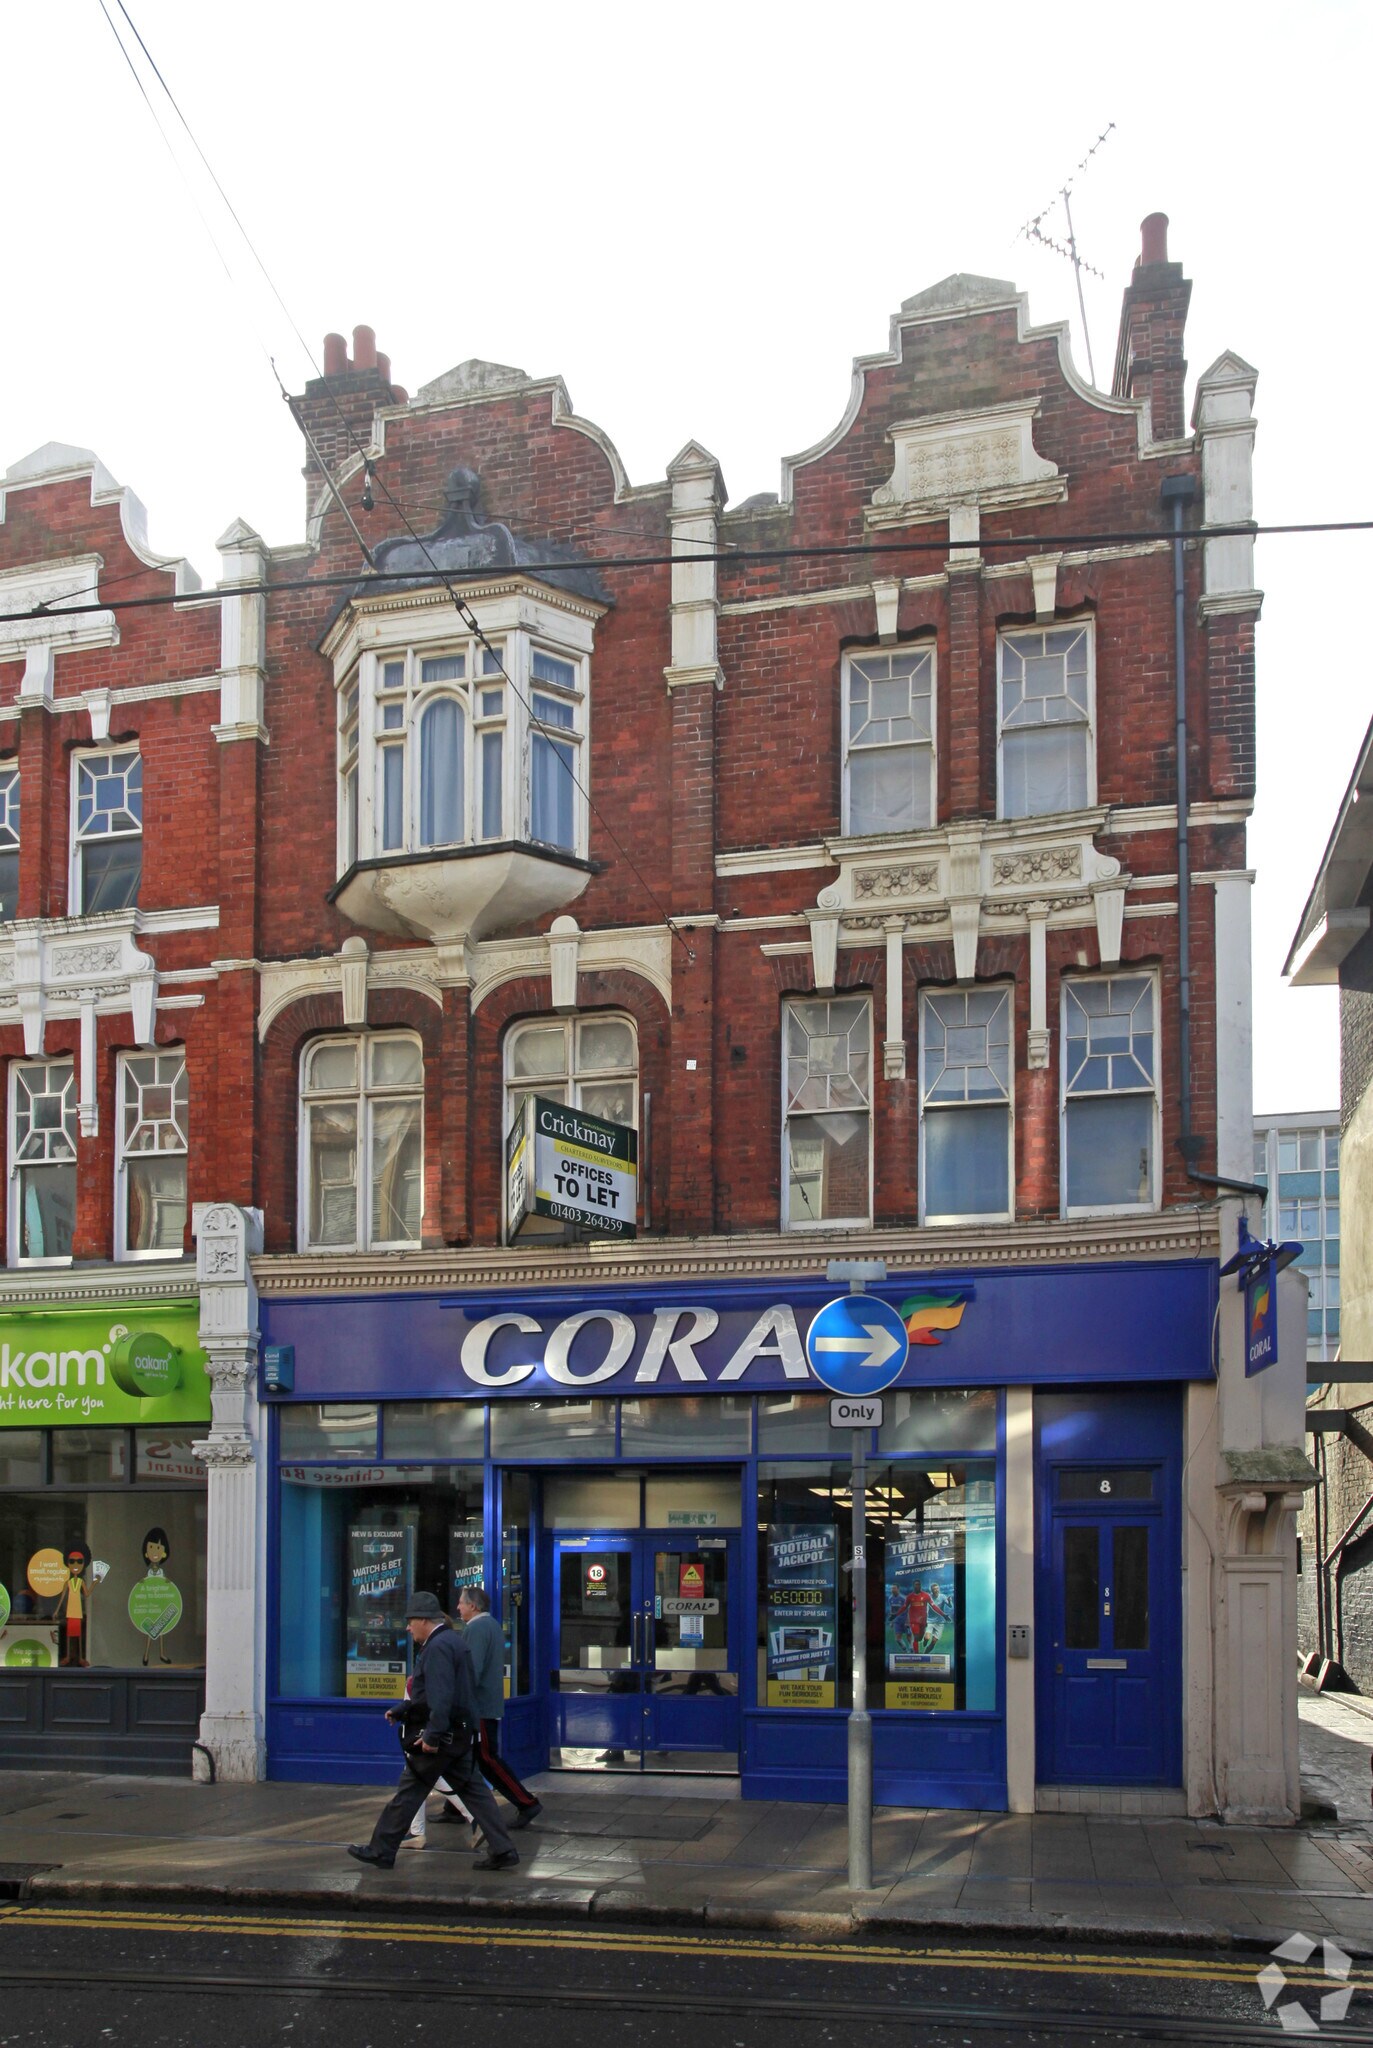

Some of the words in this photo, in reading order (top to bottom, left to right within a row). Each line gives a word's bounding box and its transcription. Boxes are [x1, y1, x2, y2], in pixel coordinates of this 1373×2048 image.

[540, 1111, 616, 1155] Crickmay
[560, 1145, 592, 1160] CHARTERED
[593, 1155, 623, 1169] SURVEYORS
[561, 1159, 613, 1186] OFFICES
[554, 1173, 580, 1198] TO
[586, 1183, 620, 1209] LET
[550, 1202, 582, 1222] 01403
[585, 1212, 623, 1233] 264259
[460, 1303, 810, 1387] CORA
[1250, 1335, 1272, 1362] CORAL
[135, 1355, 169, 1371] oakam
[18, 1394, 53, 1410] here
[55, 1392, 77, 1411] for
[81, 1394, 105, 1416] you
[838, 1405, 875, 1421] Only
[1100, 1480, 1111, 1493] 8
[773, 1536, 829, 1556] FOOTBALL
[855, 1546, 862, 1555] S
[891, 1541, 916, 1555] TWO
[917, 1536, 949, 1550] WAYS
[778, 1550, 824, 1567] JACKPOT
[901, 1555, 915, 1566] TO
[917, 1550, 939, 1563] WIN
[353, 1564, 379, 1577] WATCH
[381, 1563, 388, 1572] &
[389, 1558, 402, 1569] BET
[456, 1565, 483, 1578] WATCH
[591, 1569, 602, 1577] 18
[352, 1576, 363, 1586] ON
[364, 1572, 379, 1583] LIVE
[380, 1568, 403, 1580] SPORT
[454, 1577, 466, 1587] ON
[467, 1575, 483, 1585] LIVE
[358, 1582, 376, 1596] ALL
[378, 1577, 397, 1591] DAY
[1104, 1587, 1110, 1597] 8
[666, 1601, 708, 1611] CORAL
[786, 1655, 800, 1663] HERE
[810, 1651, 823, 1659] JUST
